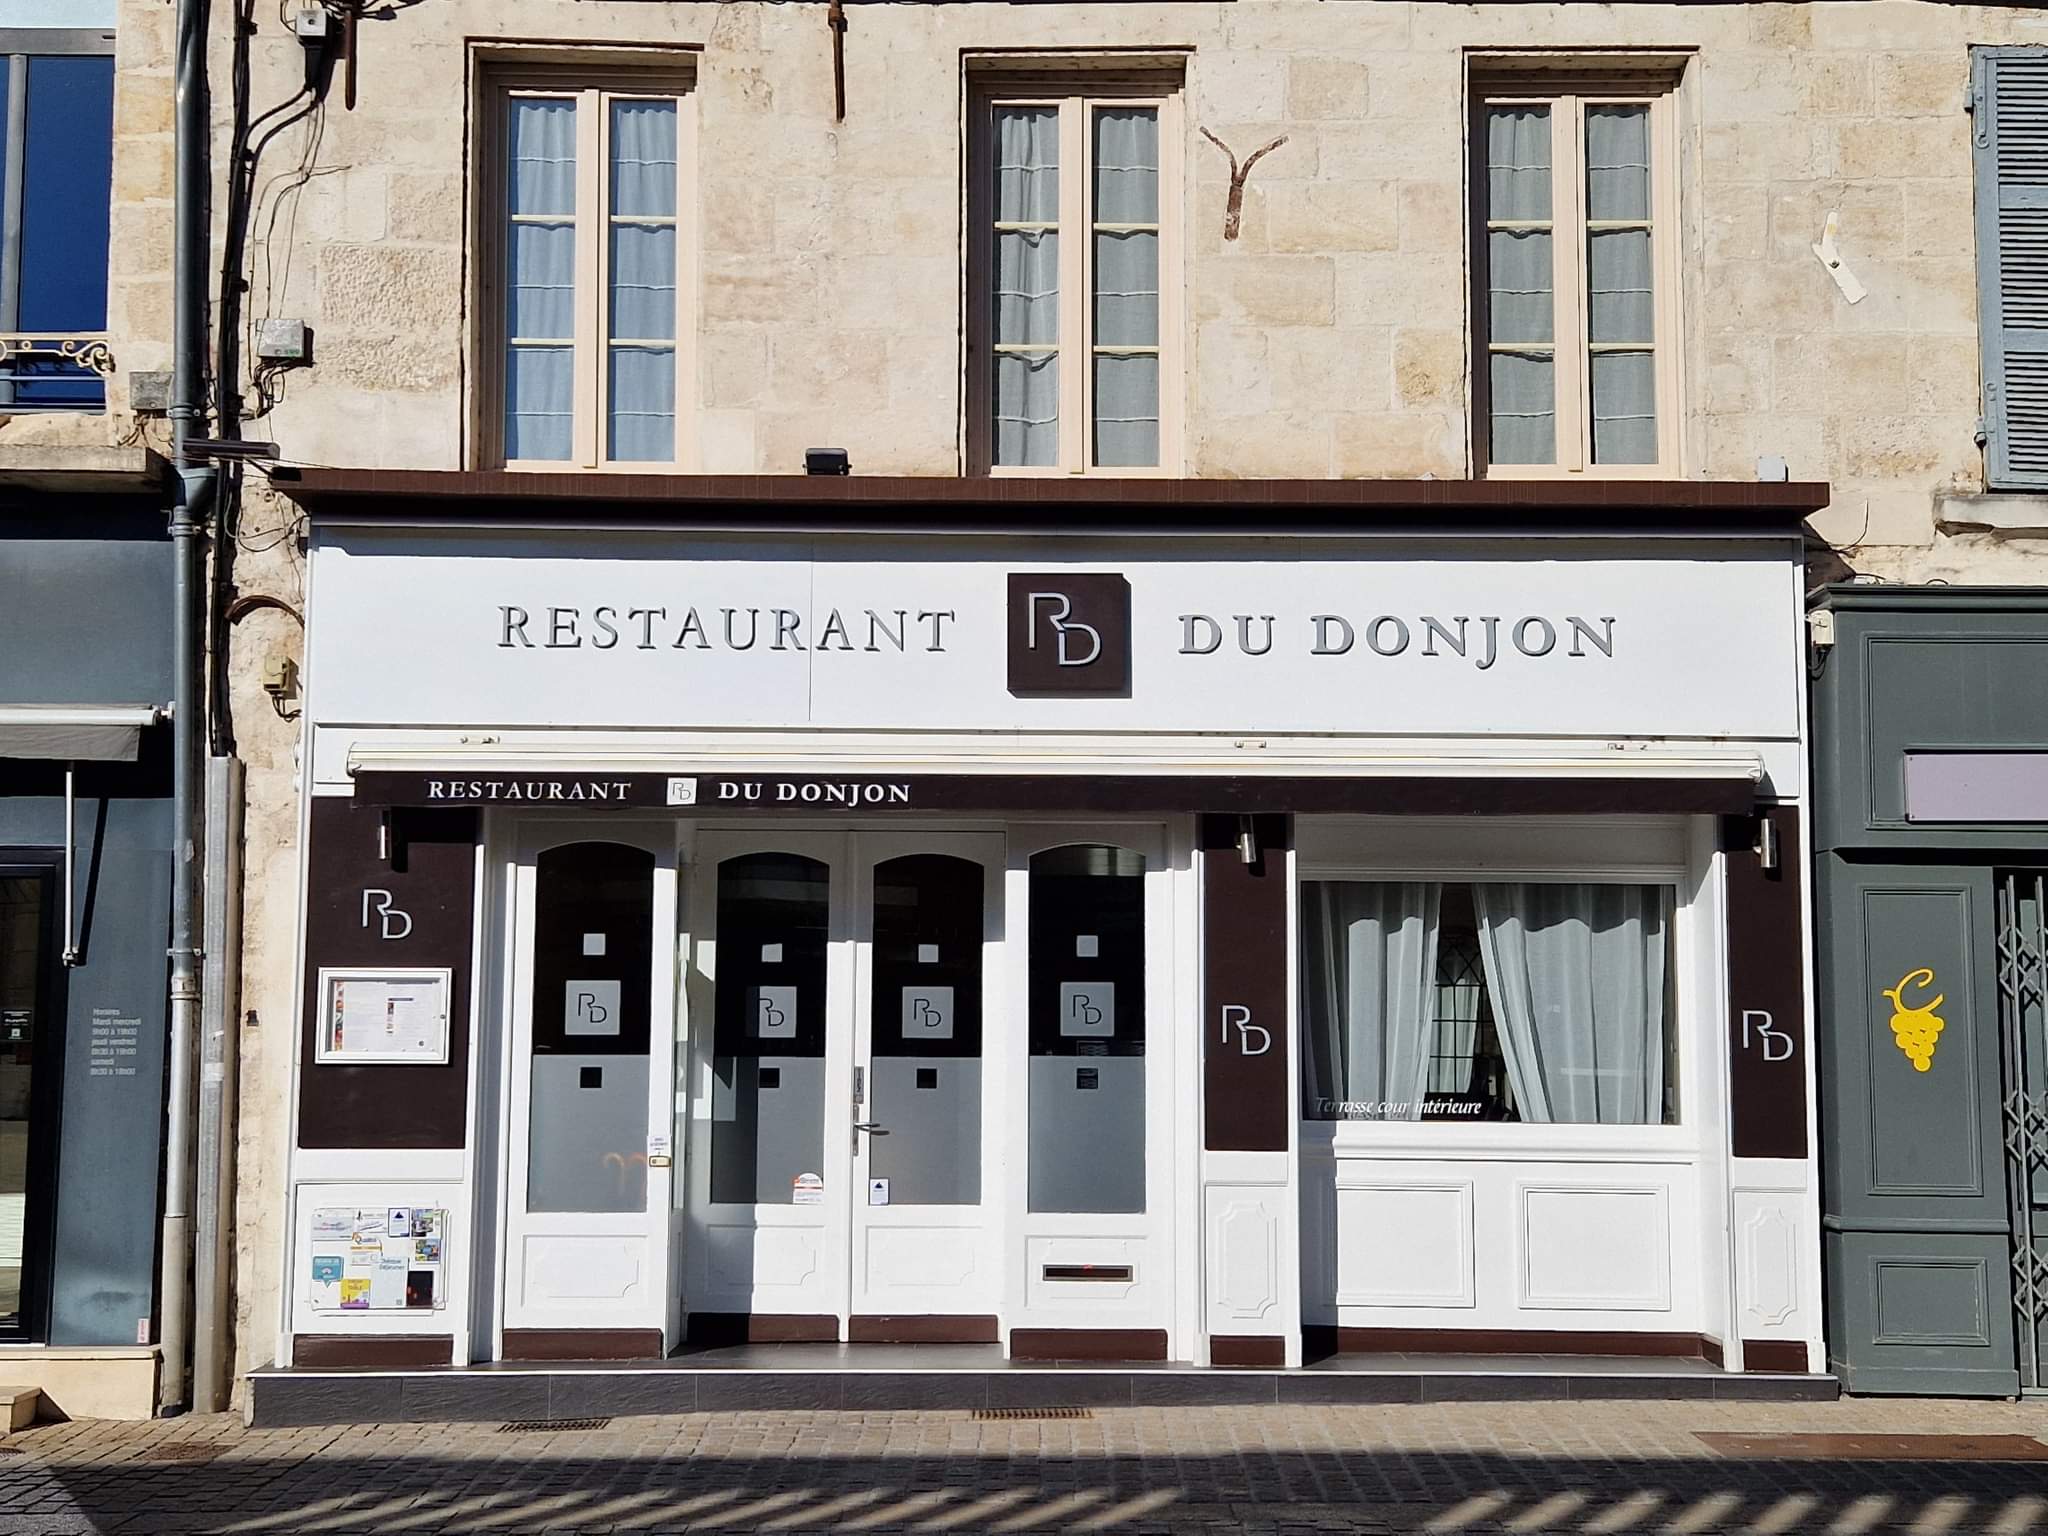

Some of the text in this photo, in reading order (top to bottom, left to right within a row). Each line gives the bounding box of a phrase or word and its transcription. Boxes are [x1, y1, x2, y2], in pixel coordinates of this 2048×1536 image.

[498, 592, 1617, 671] RESTAURANT RD DU DONJON
[428, 781, 632, 801] RESTAURANT
[718, 782, 763, 800] DU
[776, 783, 911, 807] DONJON
[361, 888, 413, 940] RD
[1221, 1005, 1272, 1056] RD
[1741, 1010, 1794, 1061] RD
[1314, 1096, 1482, 1115] Terrasse cour intérieure
